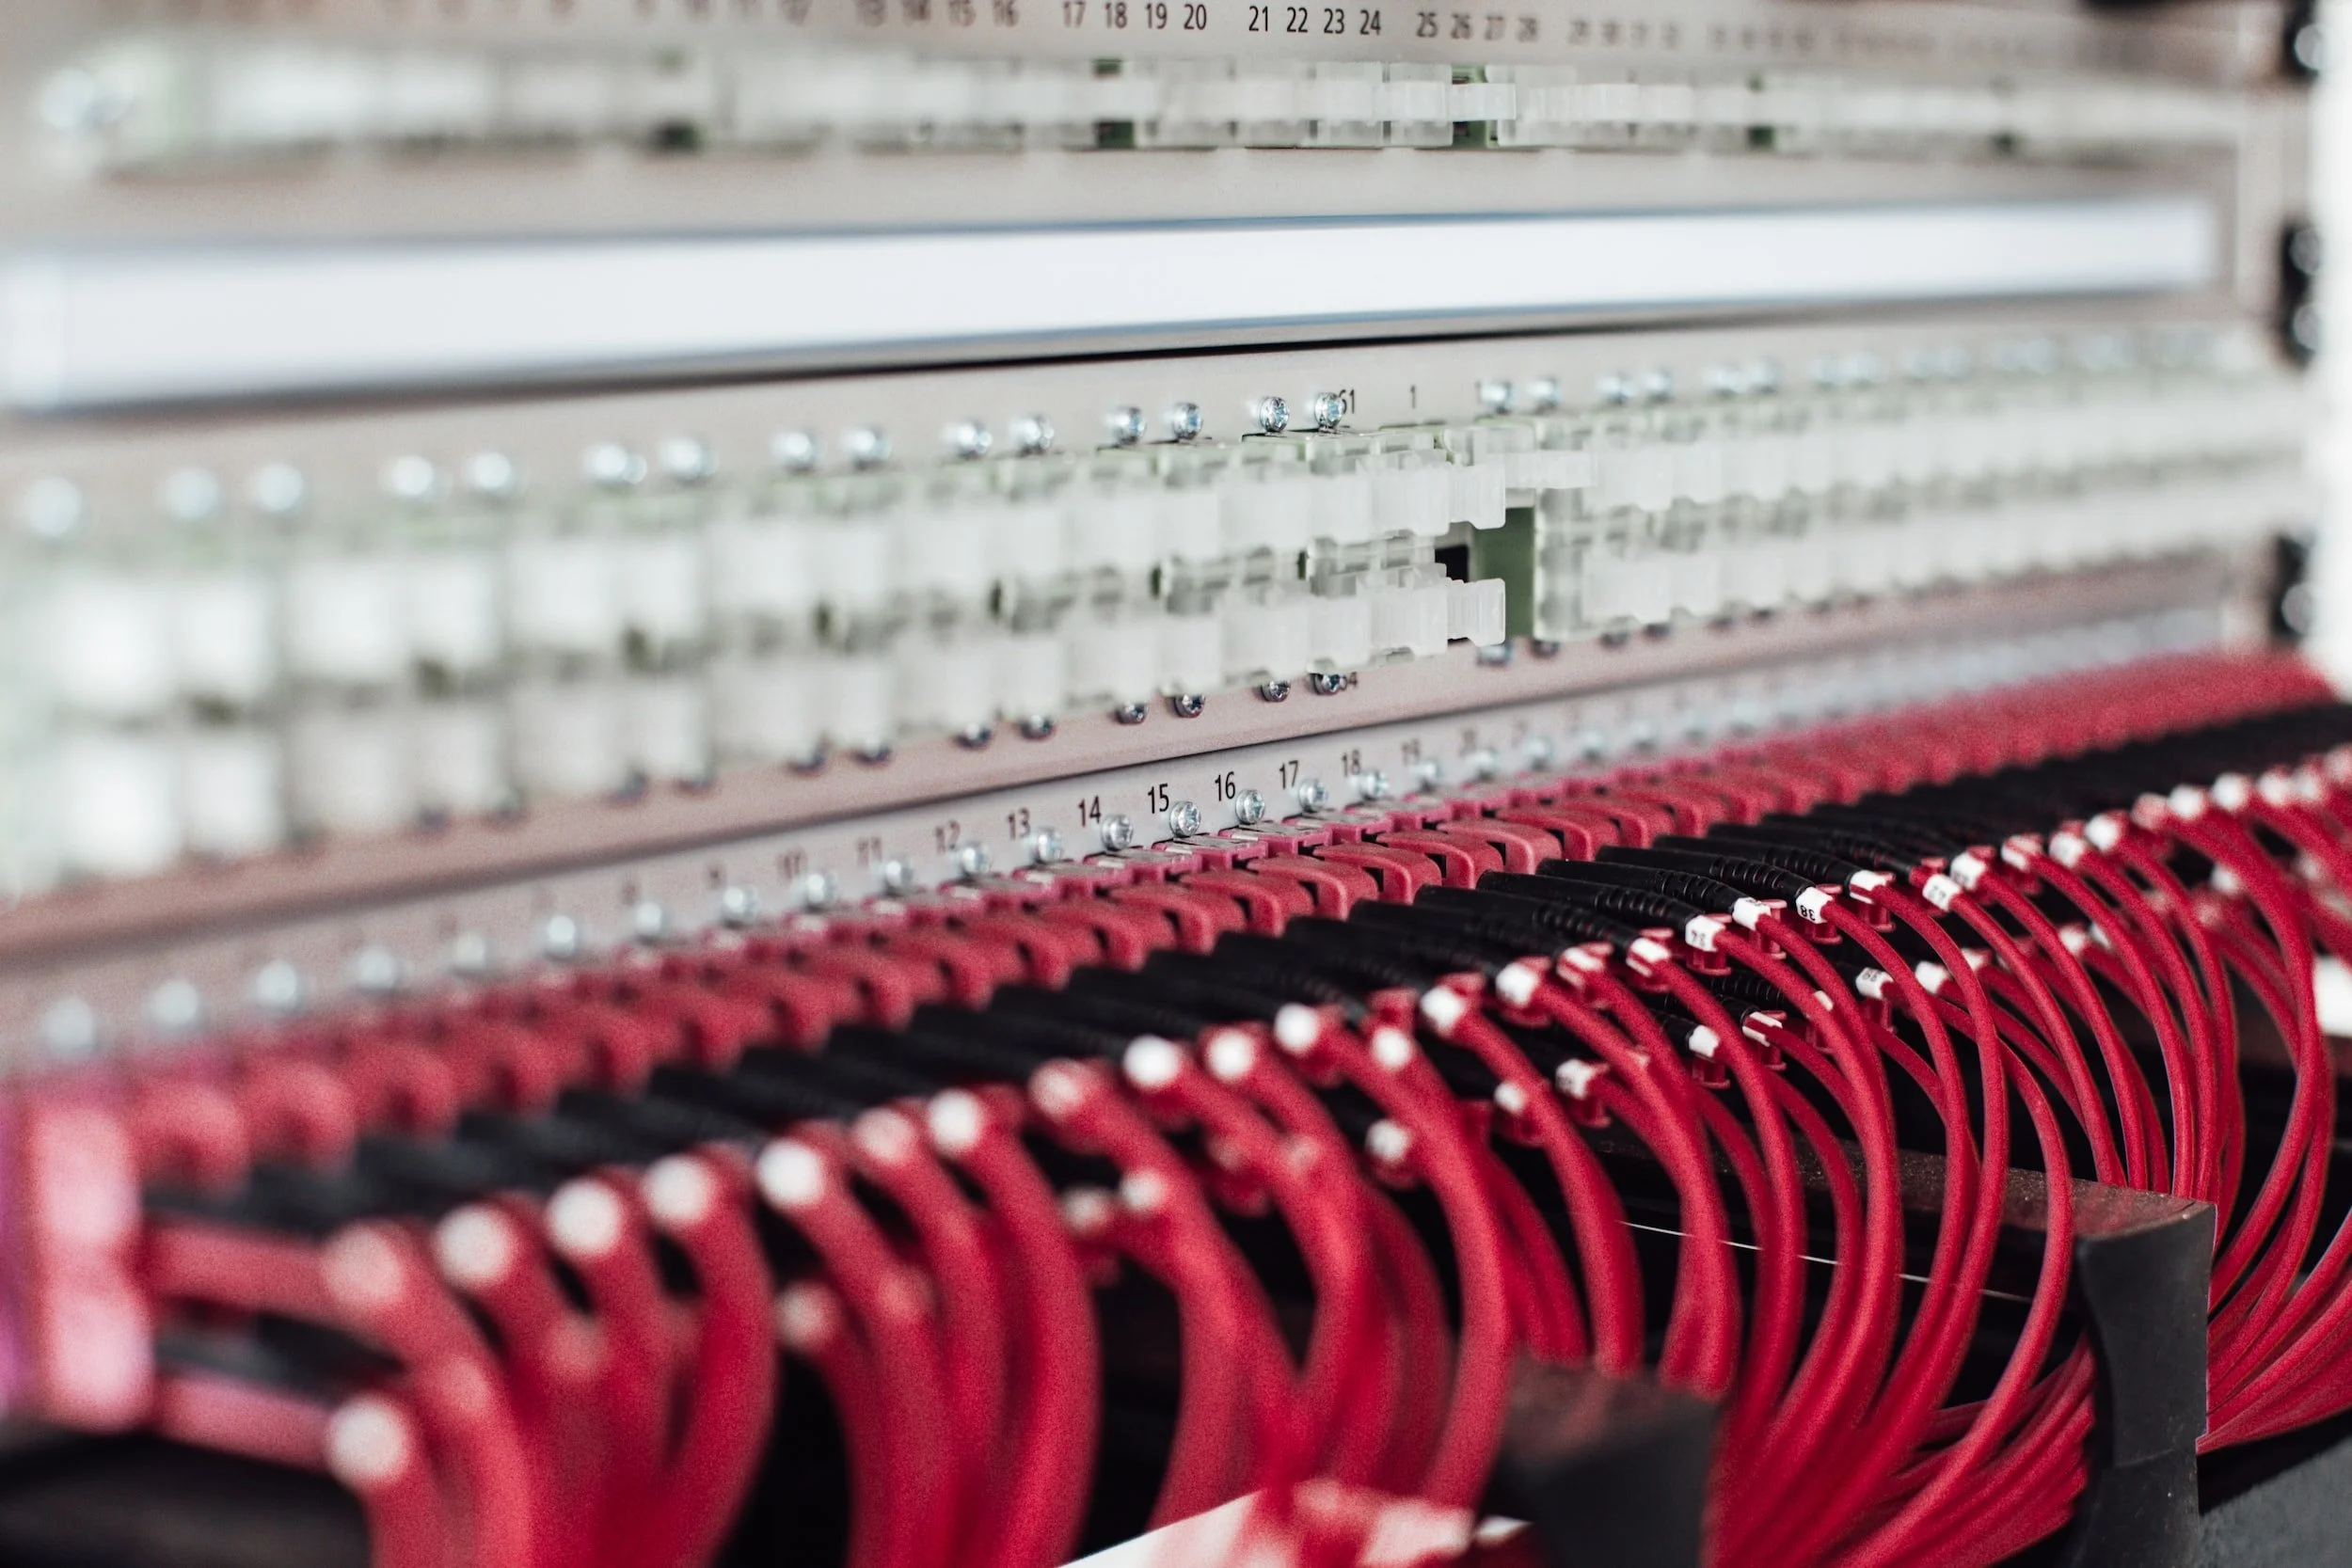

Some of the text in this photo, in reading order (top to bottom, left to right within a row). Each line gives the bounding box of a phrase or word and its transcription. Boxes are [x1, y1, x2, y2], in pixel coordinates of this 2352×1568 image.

[1063, 1, 1207, 31] 17 18 19 20
[1248, 6, 1381, 36] 21 22 23 24
[1416, 11, 1438, 38] 25
[935, 819, 961, 853] 12
[1007, 808, 1032, 840] 13
[1077, 795, 1102, 827] 14
[1147, 783, 1170, 815] 15
[1214, 771, 1237, 801] 16
[1279, 760, 1299, 789] 17
[1341, 750, 1362, 777] 18
